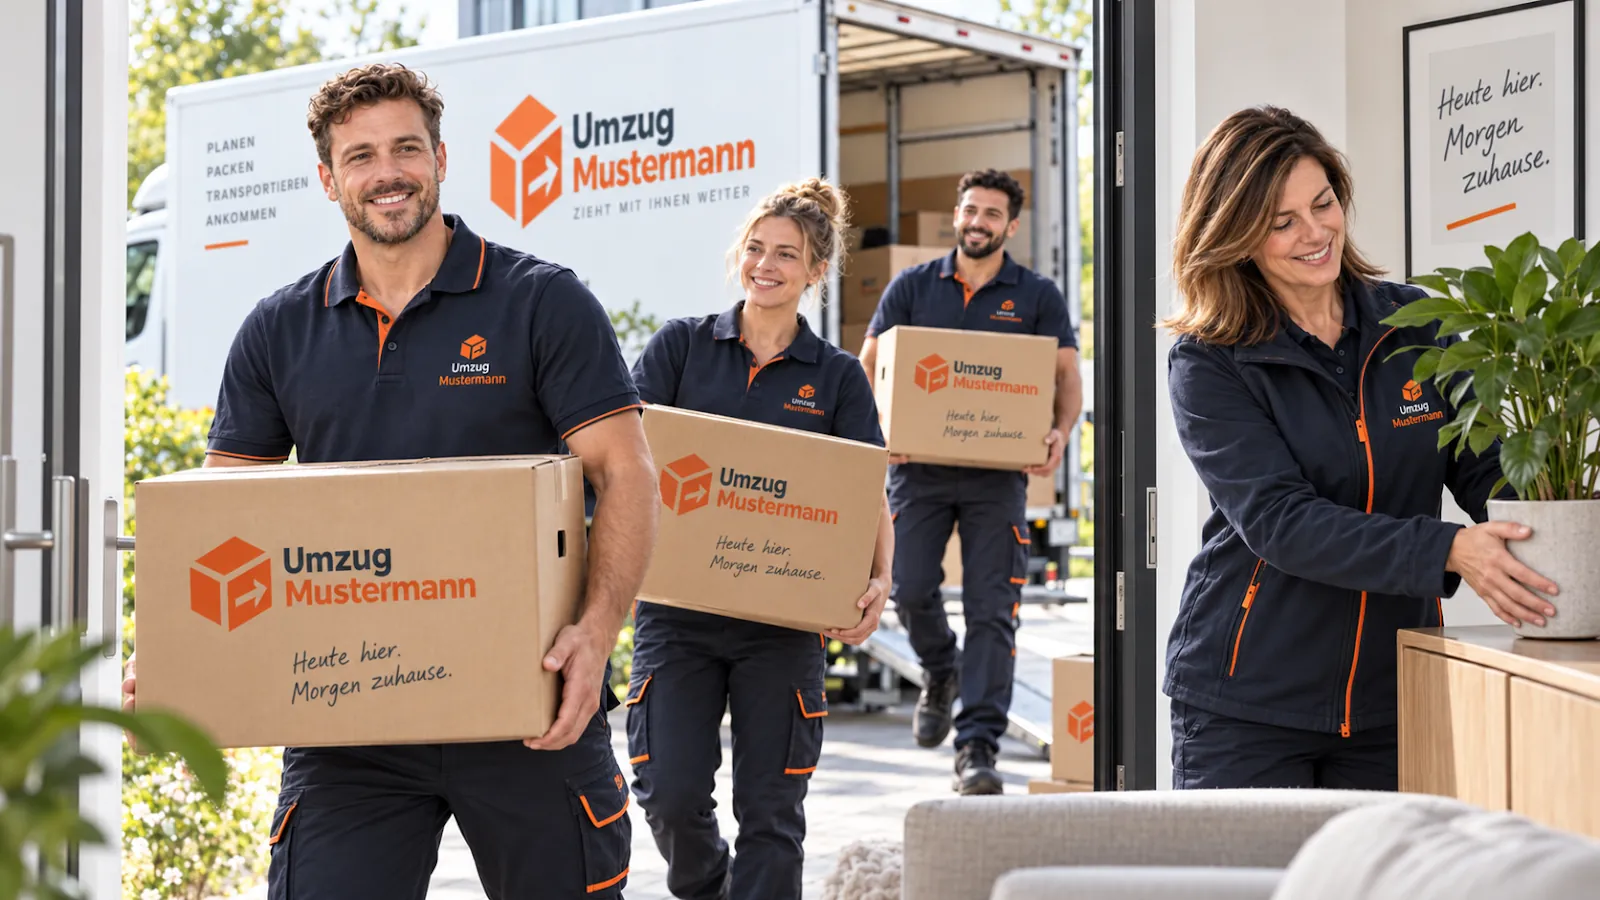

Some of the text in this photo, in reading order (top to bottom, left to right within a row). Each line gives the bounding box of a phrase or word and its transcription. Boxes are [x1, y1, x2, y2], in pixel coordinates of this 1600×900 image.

[1437, 69, 1543, 120] Heute hier.
[572, 107, 675, 149] Umzug
[1444, 117, 1523, 162] Morgen
[207, 136, 255, 153] PLANEN
[206, 160, 254, 177] PACKEN
[573, 138, 755, 193] Mustermann
[1462, 150, 1550, 194] zuhause.
[206, 176, 309, 202] TRANSPORTIEREN
[573, 185, 751, 220] ZIEHT MIT IHNEN WEITER
[205, 207, 277, 226] ANKOMMEN
[439, 375, 507, 386] Mustermann
[451, 362, 490, 374] Umzug
[953, 360, 1003, 380] Umzug
[953, 376, 1039, 396] Mustermann
[946, 409, 1002, 423] Heute hier.
[1391, 410, 1444, 428] Mustermann
[1400, 402, 1430, 415] Umzug
[942, 425, 1027, 442] Morgen zuhause.
[719, 467, 788, 499] Umzug
[716, 490, 839, 525] Mustermann
[716, 535, 792, 557] Heute hier.
[283, 546, 392, 577] Umzug
[709, 555, 826, 581] Morgen zuhause.
[285, 577, 477, 607] Mustermann
[293, 640, 401, 674] Heute hier.
[291, 664, 453, 707] Morgen zuhause.
